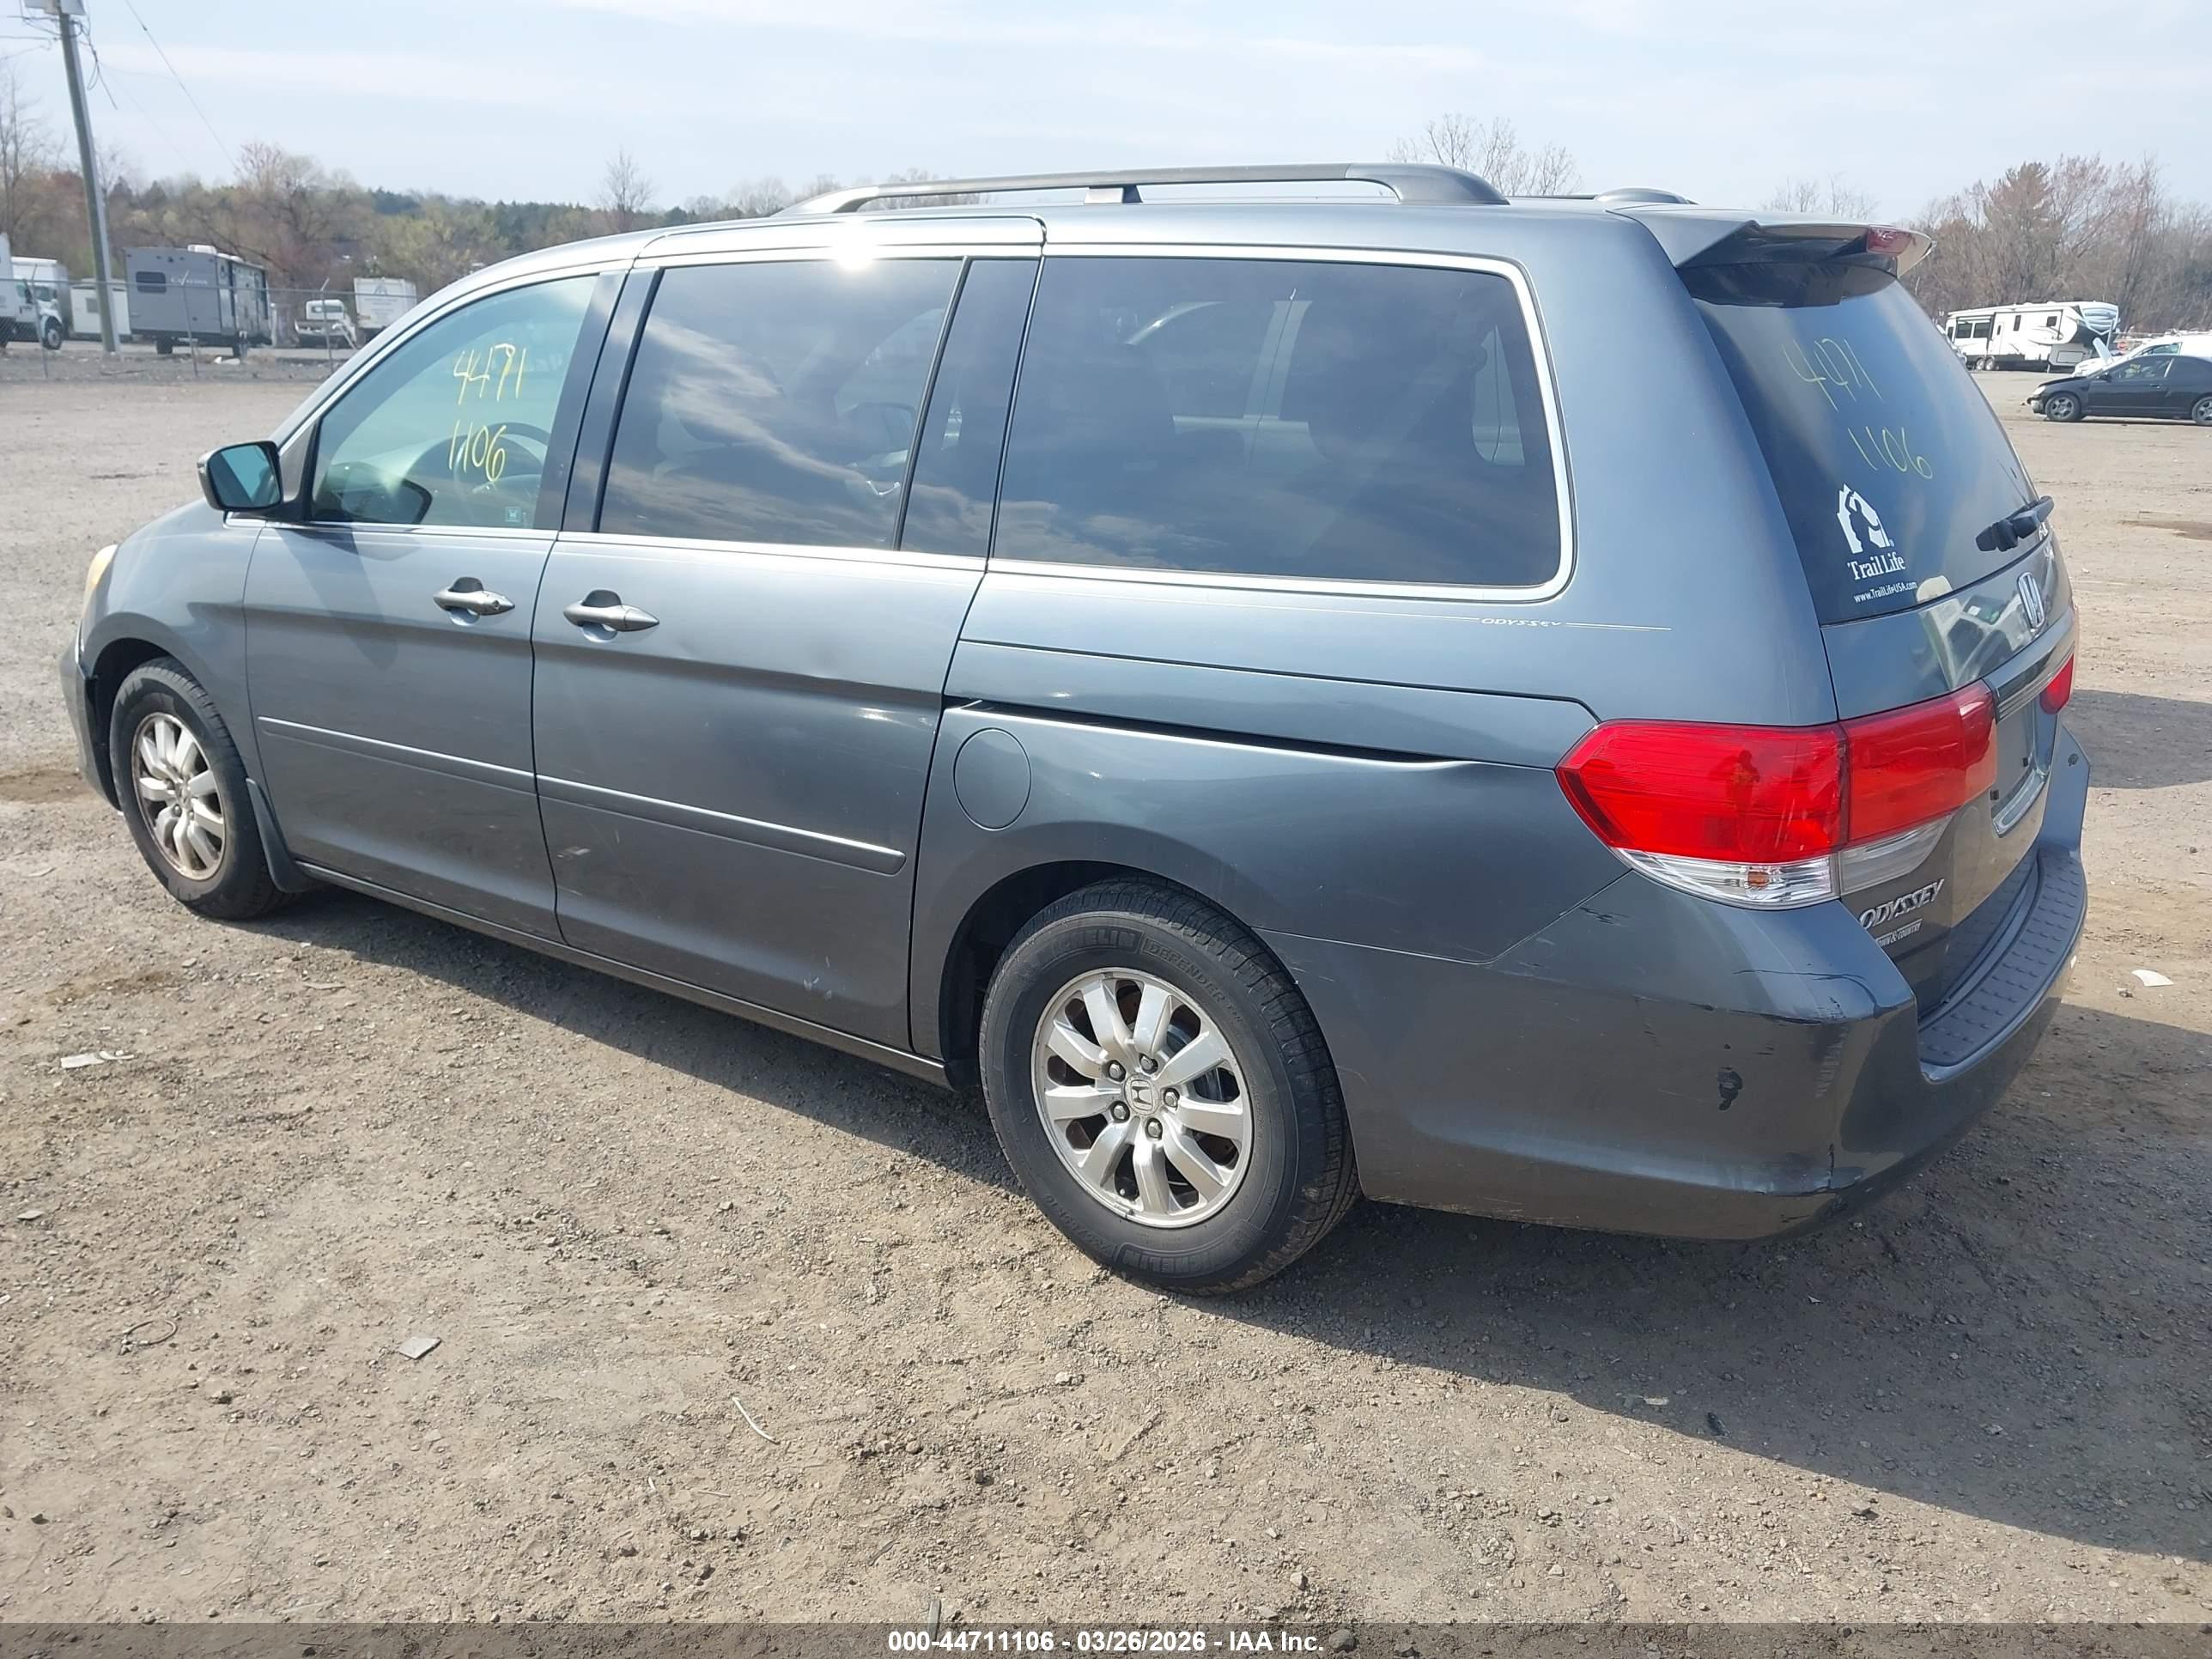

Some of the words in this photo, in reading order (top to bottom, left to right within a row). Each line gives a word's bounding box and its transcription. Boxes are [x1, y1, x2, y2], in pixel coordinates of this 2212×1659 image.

[453, 343, 526, 405] 4471
[448, 419, 507, 482] 1106
[1848, 426, 1933, 478] 1106
[1847, 555, 1885, 580] Trail
[1881, 551, 1906, 574] Life
[1854, 581, 1918, 603] www.TrailLifeUSA.com
[1481, 617, 1562, 627] ODYSSEY
[1860, 878, 1945, 930] ODYSSEY
[1146, 939, 1227, 1003] DEFENDER
